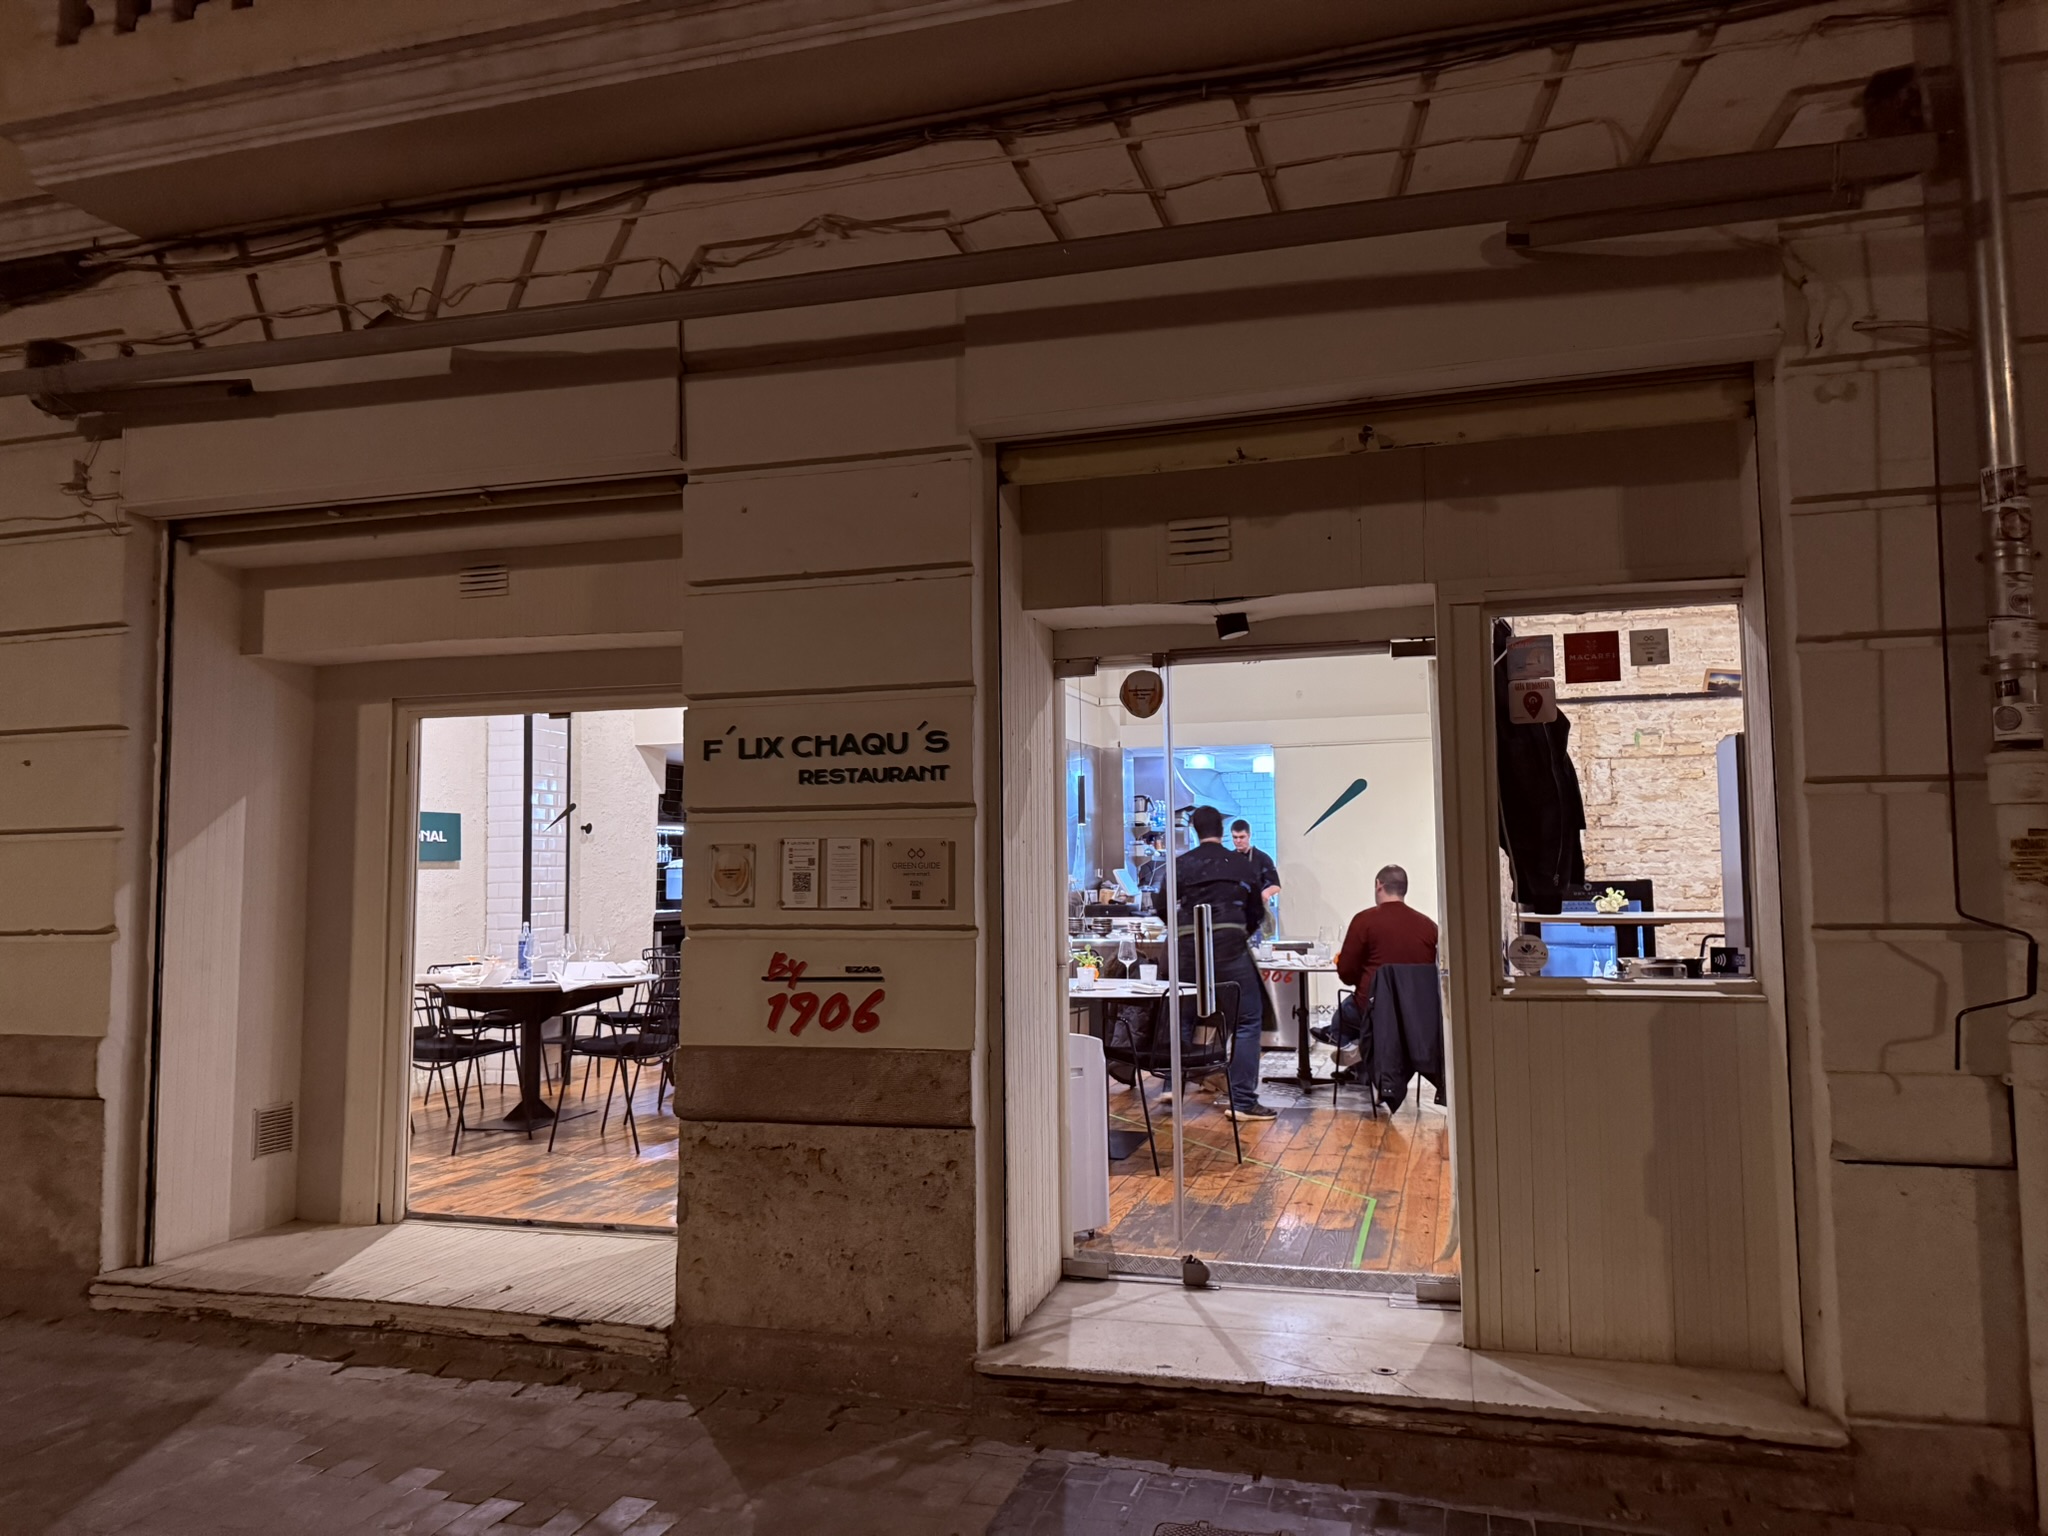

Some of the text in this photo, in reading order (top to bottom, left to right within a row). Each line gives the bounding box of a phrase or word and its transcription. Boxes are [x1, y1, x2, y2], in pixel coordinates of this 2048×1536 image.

[798, 764, 950, 785] RESTAURANT
[418, 829, 448, 842] NAL
[891, 861, 941, 870] GREEN GUIDE
[767, 988, 886, 1038] 1906
